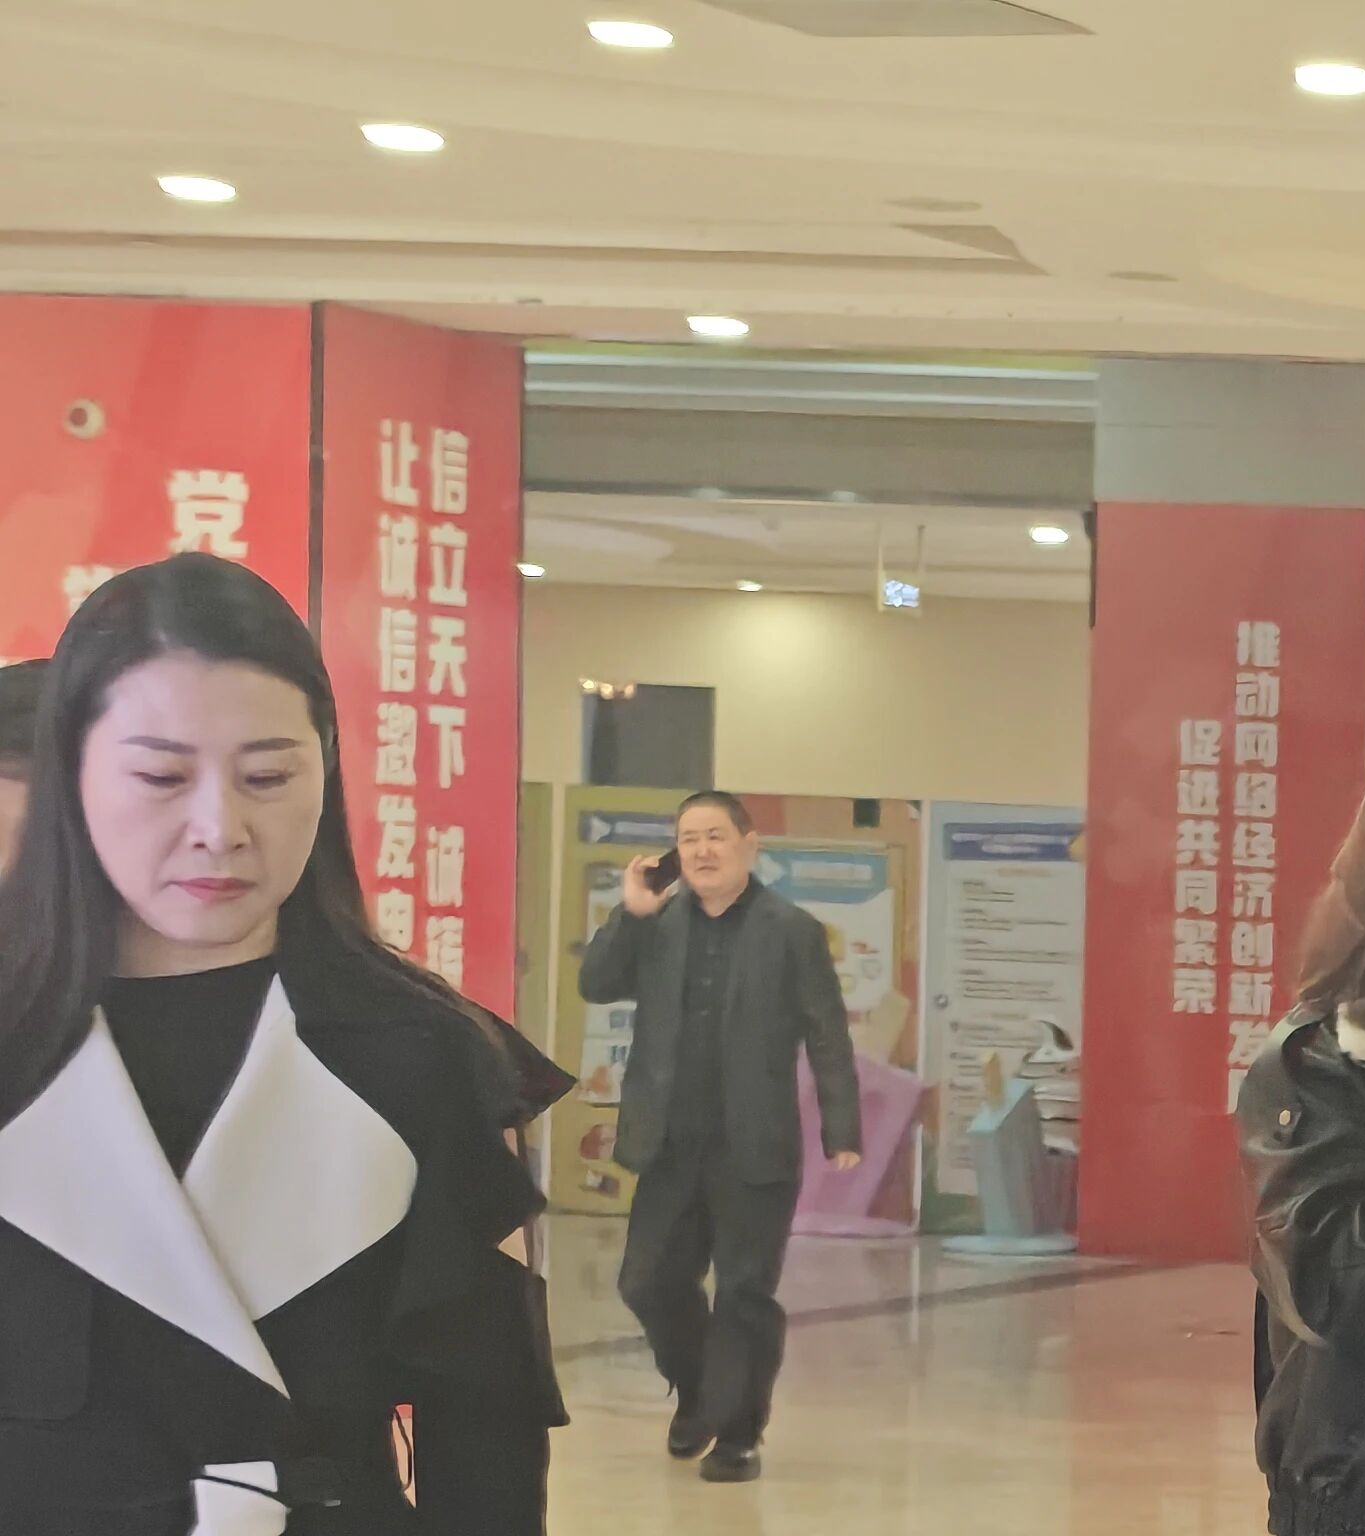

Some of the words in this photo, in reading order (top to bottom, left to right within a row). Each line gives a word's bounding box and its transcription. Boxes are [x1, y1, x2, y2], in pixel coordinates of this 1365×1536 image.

[1227, 620, 1281, 1114] 推动网络经济创新发
